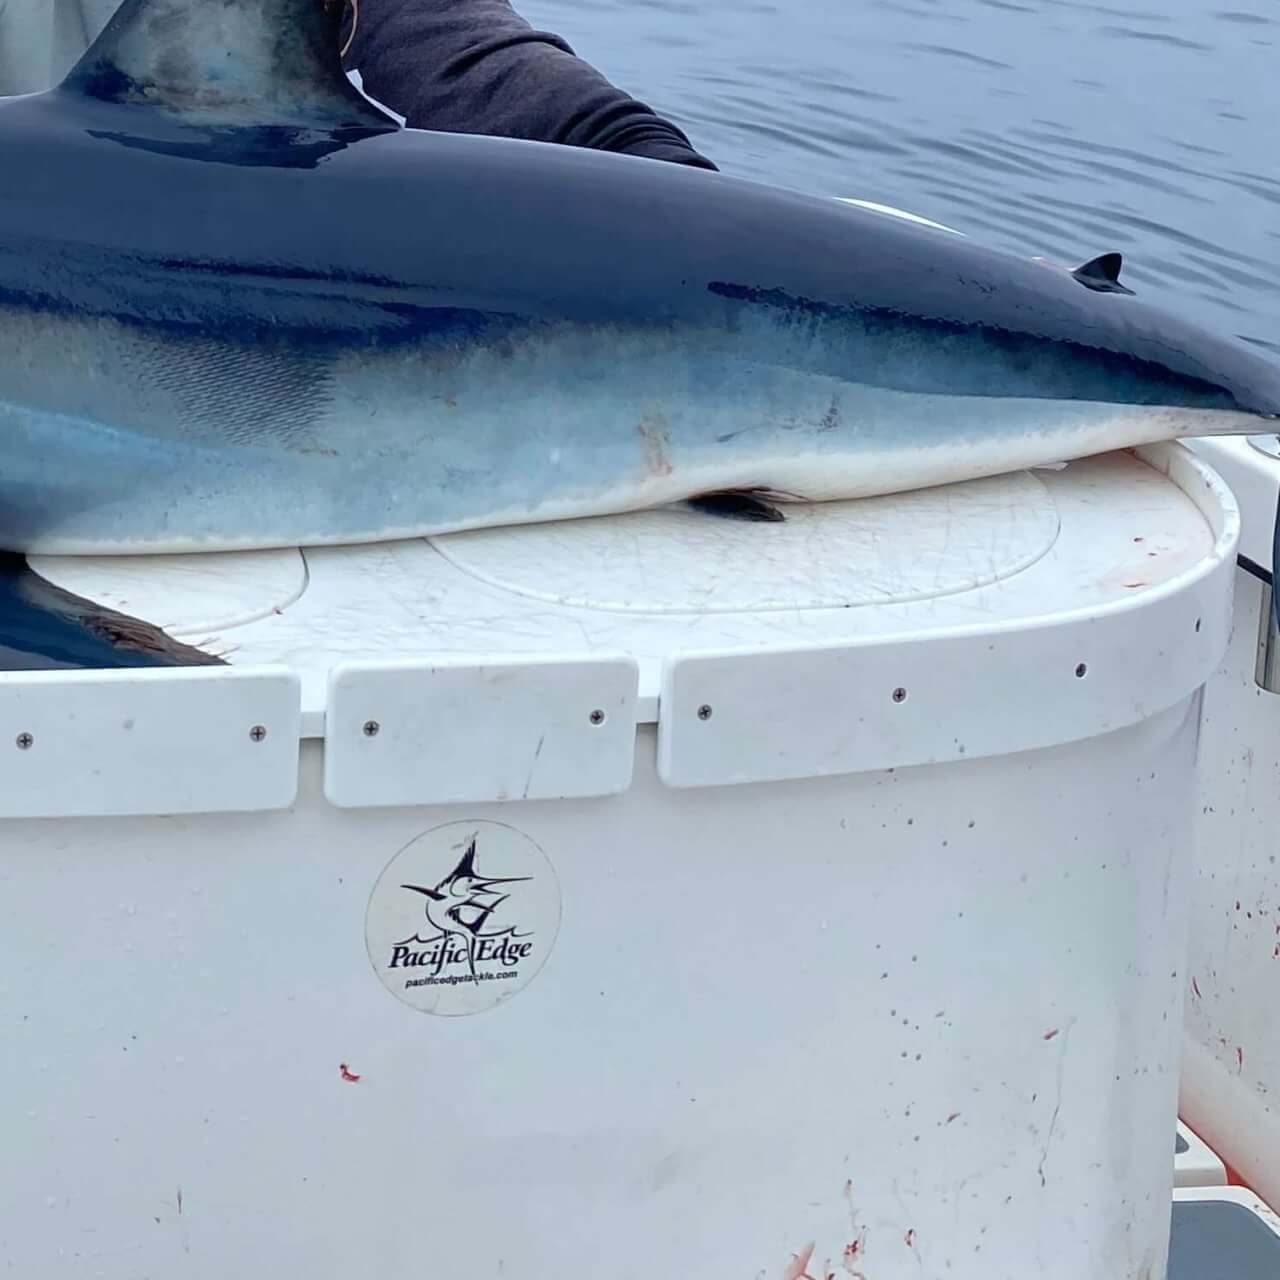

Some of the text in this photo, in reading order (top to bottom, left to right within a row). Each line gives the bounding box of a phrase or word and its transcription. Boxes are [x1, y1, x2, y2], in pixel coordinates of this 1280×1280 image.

[388, 936, 533, 976] Pacific Edge
[405, 970, 518, 989] pacificedgetackle.com
